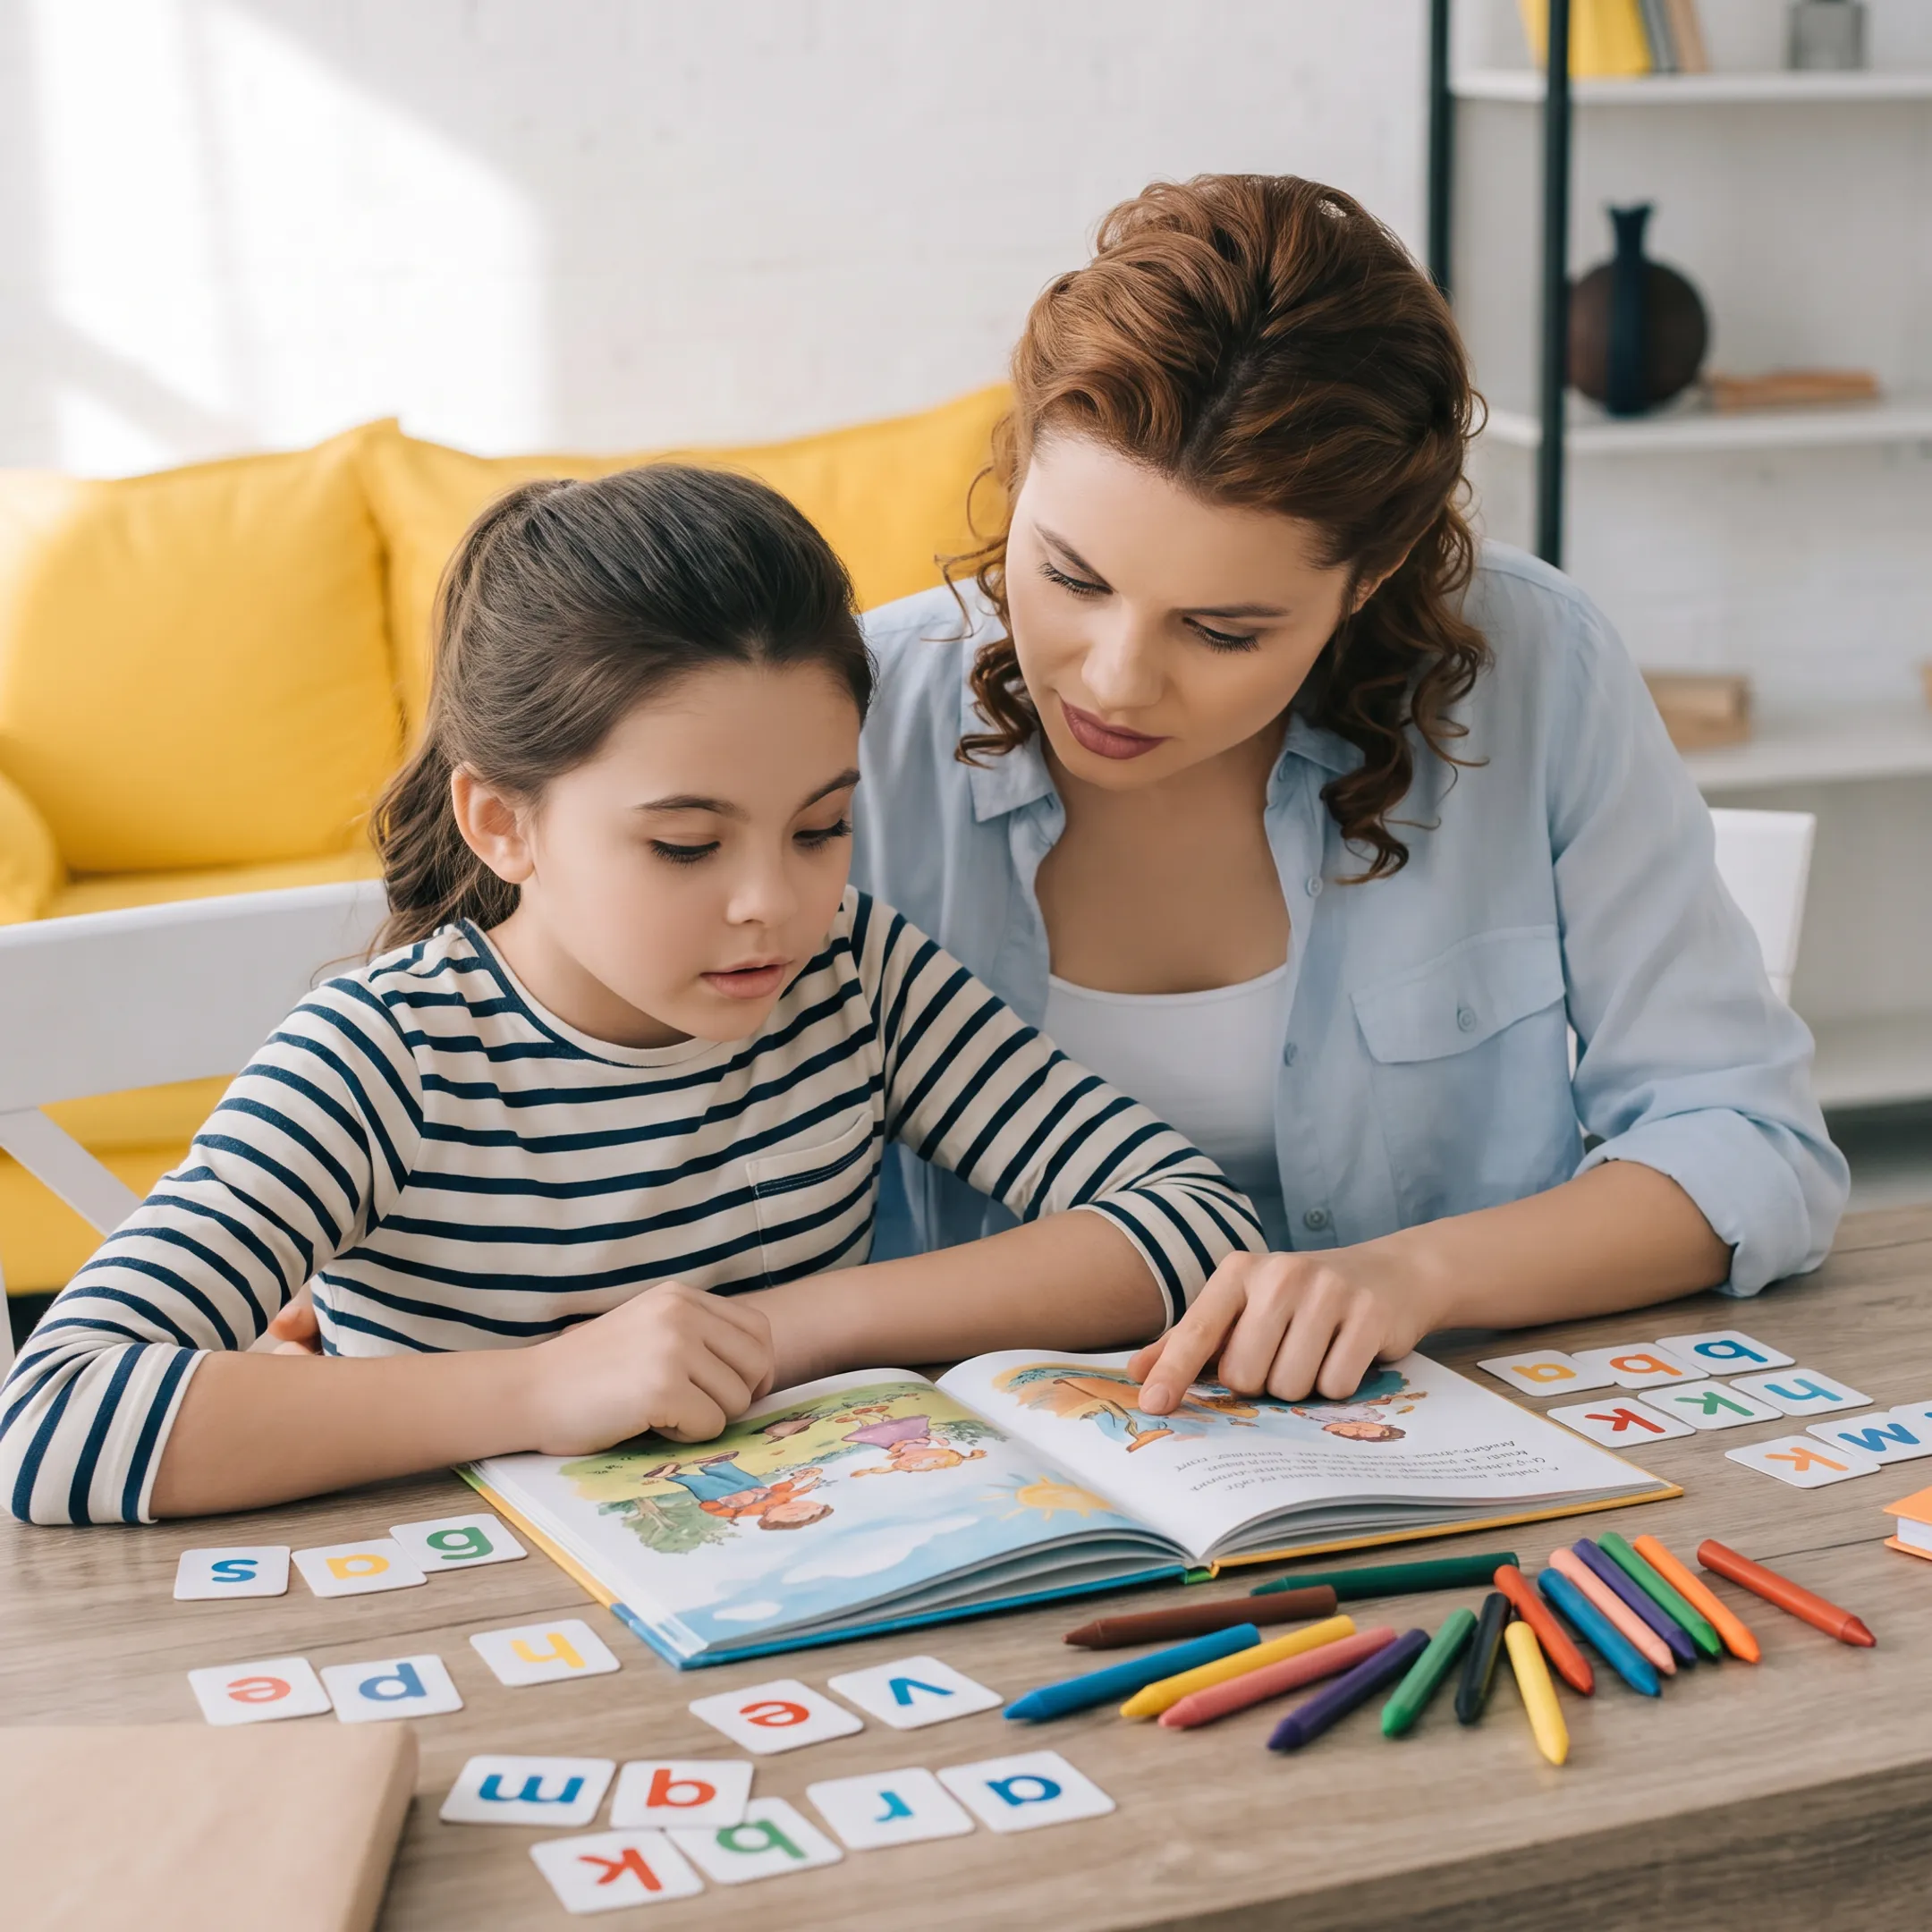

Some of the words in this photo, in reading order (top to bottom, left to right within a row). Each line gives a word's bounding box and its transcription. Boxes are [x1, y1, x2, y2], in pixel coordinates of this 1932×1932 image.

[1674, 1391, 1755, 1417] k
[1585, 1408, 1665, 1434] k
[1764, 1447, 1849, 1471] k
[427, 1527, 494, 1560] g
[211, 1559, 258, 1582] s
[227, 1676, 291, 1703] e
[739, 1701, 810, 1727] e
[577, 1848, 663, 1892] k
